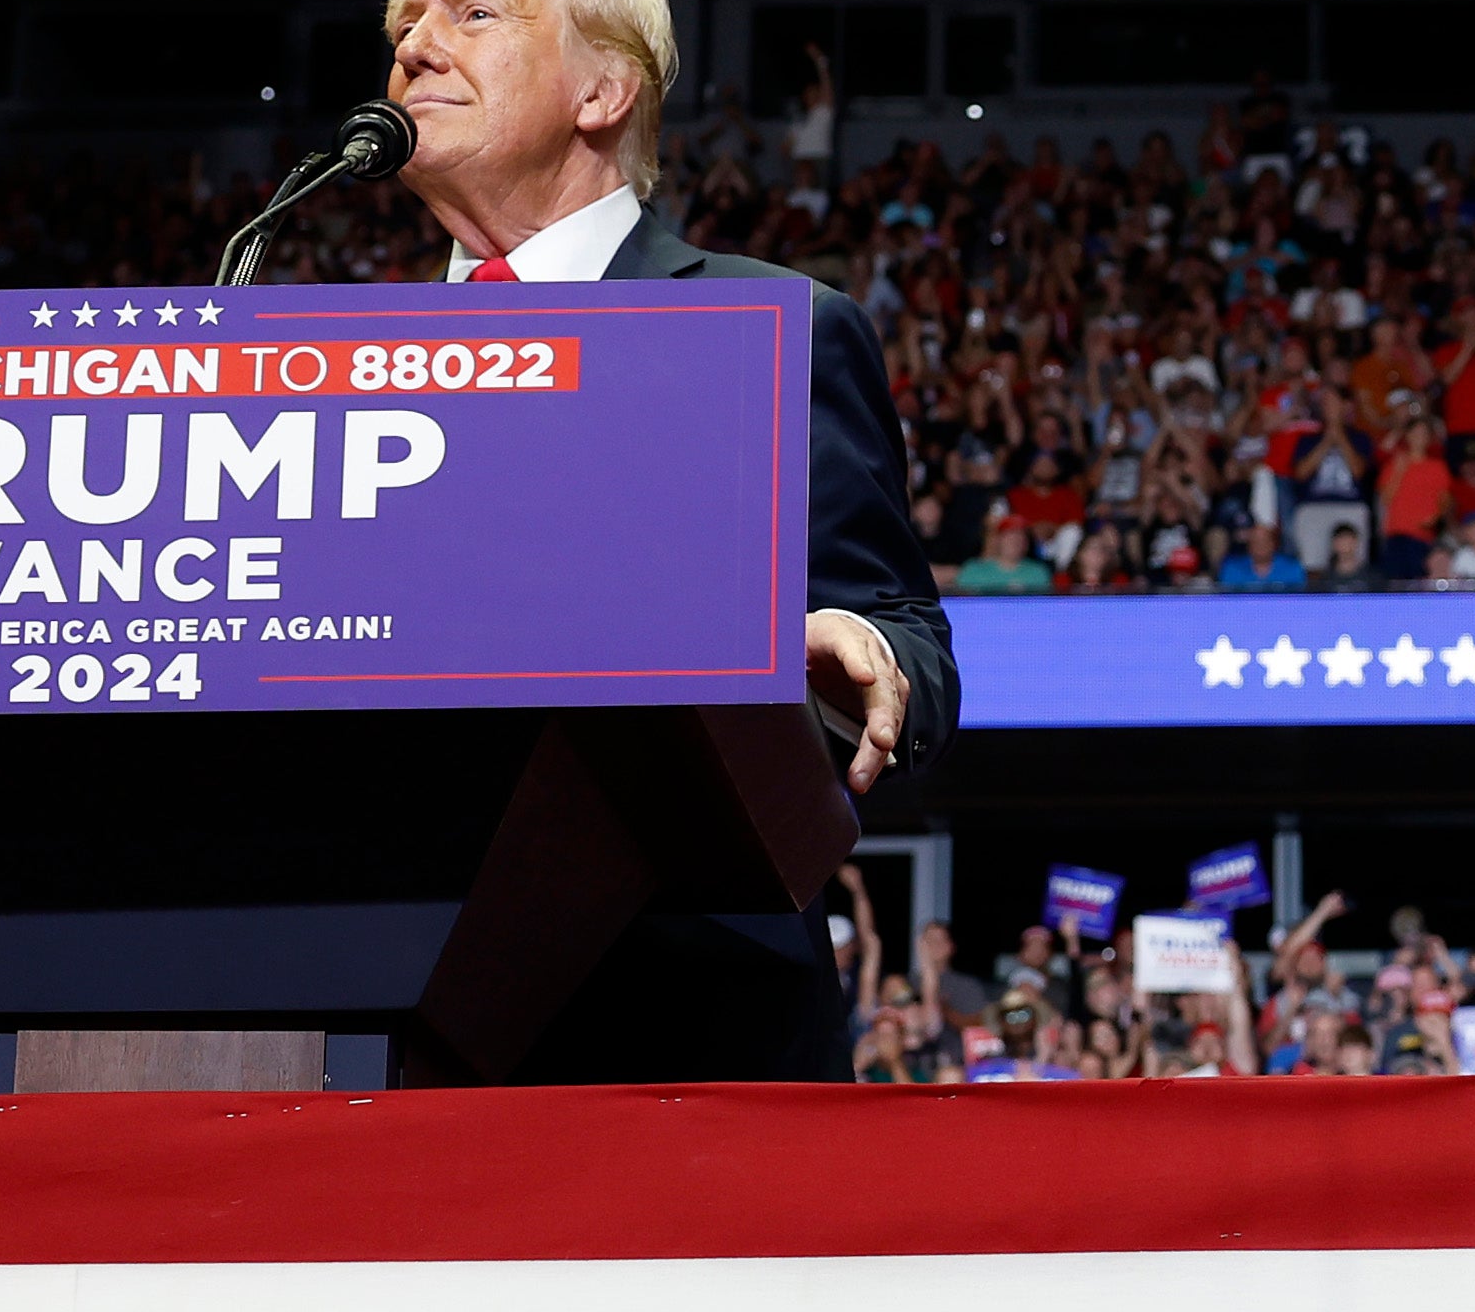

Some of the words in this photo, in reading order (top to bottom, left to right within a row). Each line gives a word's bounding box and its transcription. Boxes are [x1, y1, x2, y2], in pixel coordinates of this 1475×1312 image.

[241, 346, 328, 392] TO
[349, 342, 554, 391] 88022
[126, 617, 248, 643] GREAT
[260, 615, 393, 641] AGAIN!
[9, 652, 202, 703] 2024
